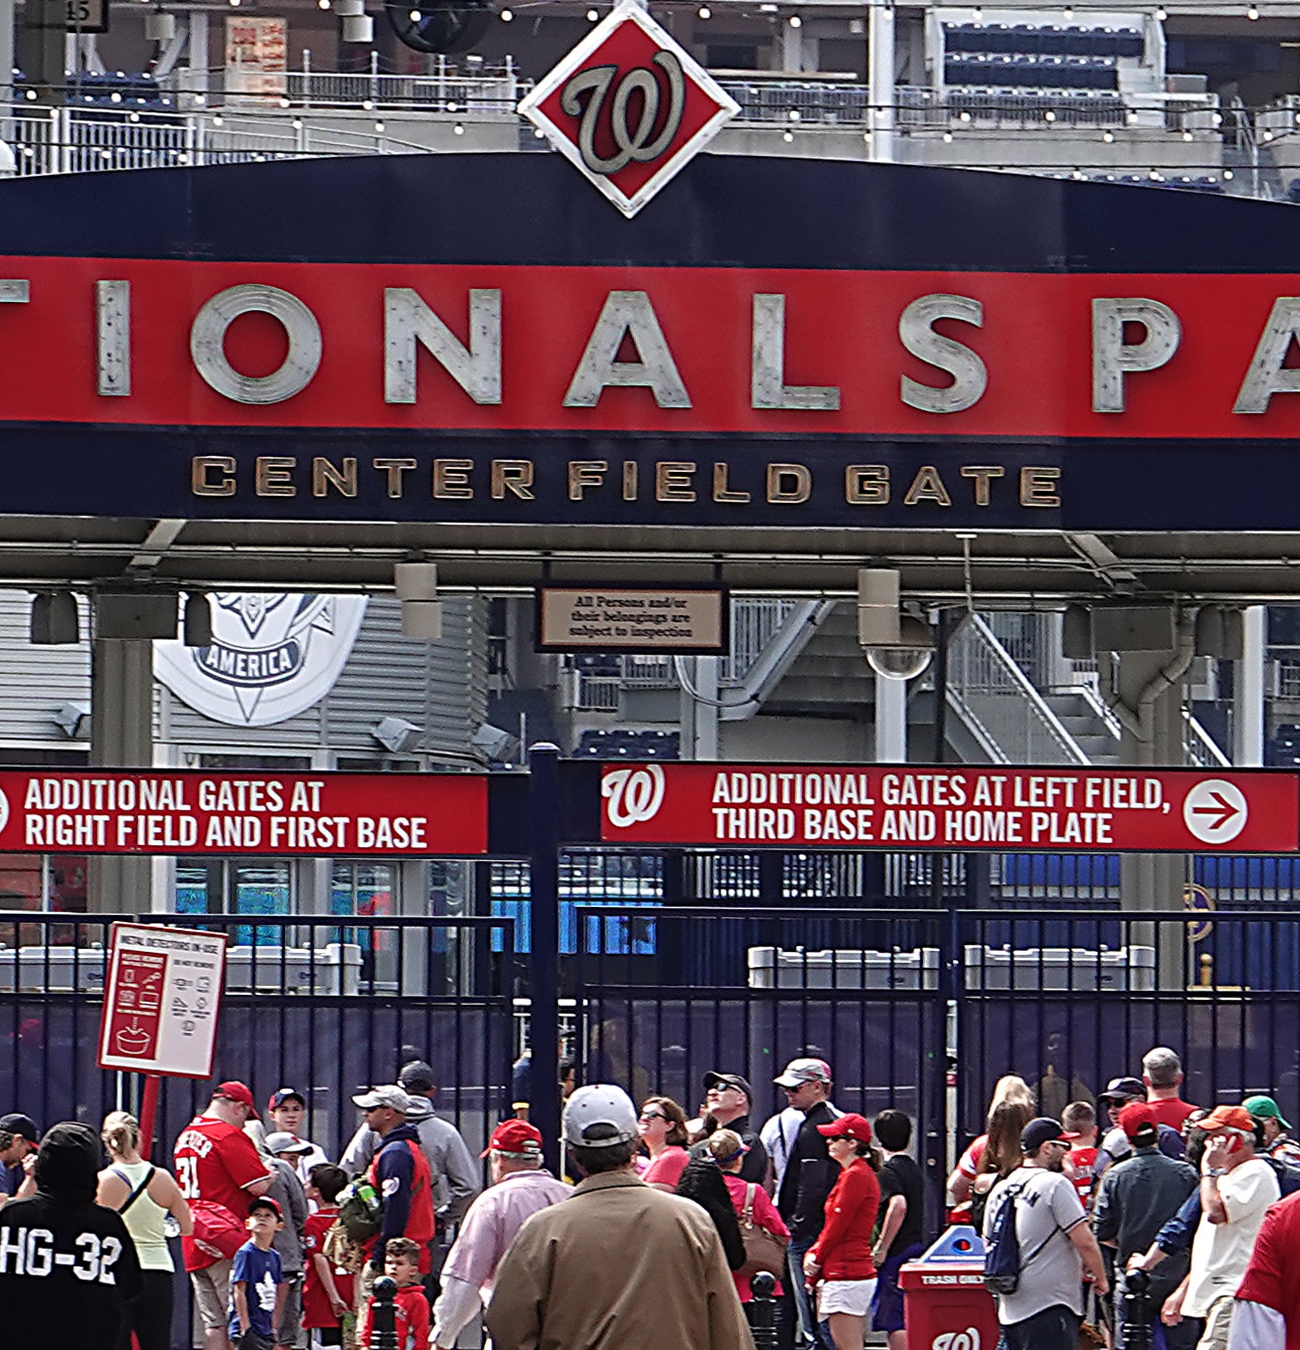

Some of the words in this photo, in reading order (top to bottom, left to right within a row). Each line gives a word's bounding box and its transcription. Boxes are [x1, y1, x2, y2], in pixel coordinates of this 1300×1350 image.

[561, 51, 686, 175] W
[191, 455, 535, 501] CENTER
[568, 460, 812, 504] FIELD
[845, 464, 1062, 508] GATE
[571, 611, 601, 623] their
[603, 611, 668, 626] belongings
[671, 613, 691, 624] are
[574, 596, 593, 608] All
[597, 596, 645, 609] Persons
[648, 597, 688, 609] and/or
[569, 626, 613, 639] subject
[615, 626, 628, 638] to
[631, 626, 693, 640] inspection
[205, 644, 293, 678] AMERICA
[24, 777, 190, 811] ADDITIONAL
[197, 779, 284, 812] GATES
[290, 781, 325, 812] AT
[602, 764, 665, 828] W
[711, 772, 876, 806] ADDITIONAL
[882, 774, 968, 807] GATES
[973, 776, 1005, 807] AT
[1013, 776, 1079, 808] LEFT
[1084, 777, 1172, 814] FIELD,
[25, 814, 110, 846] RIGHT
[117, 815, 198, 847] FIELD
[204, 815, 262, 848] AND
[269, 816, 350, 848] FIRST
[356, 816, 428, 849] BASE
[711, 807, 795, 840] THIRD
[803, 808, 872, 841] BASE
[880, 809, 936, 841] AND
[945, 810, 1023, 842] HOME
[1031, 812, 1113, 844] PLATE
[121, 935, 145, 946] METAL
[147, 937, 190, 952] DETECTORS
[175, 1155, 201, 1199] 31
[921, 1274, 958, 1285] TRASH
